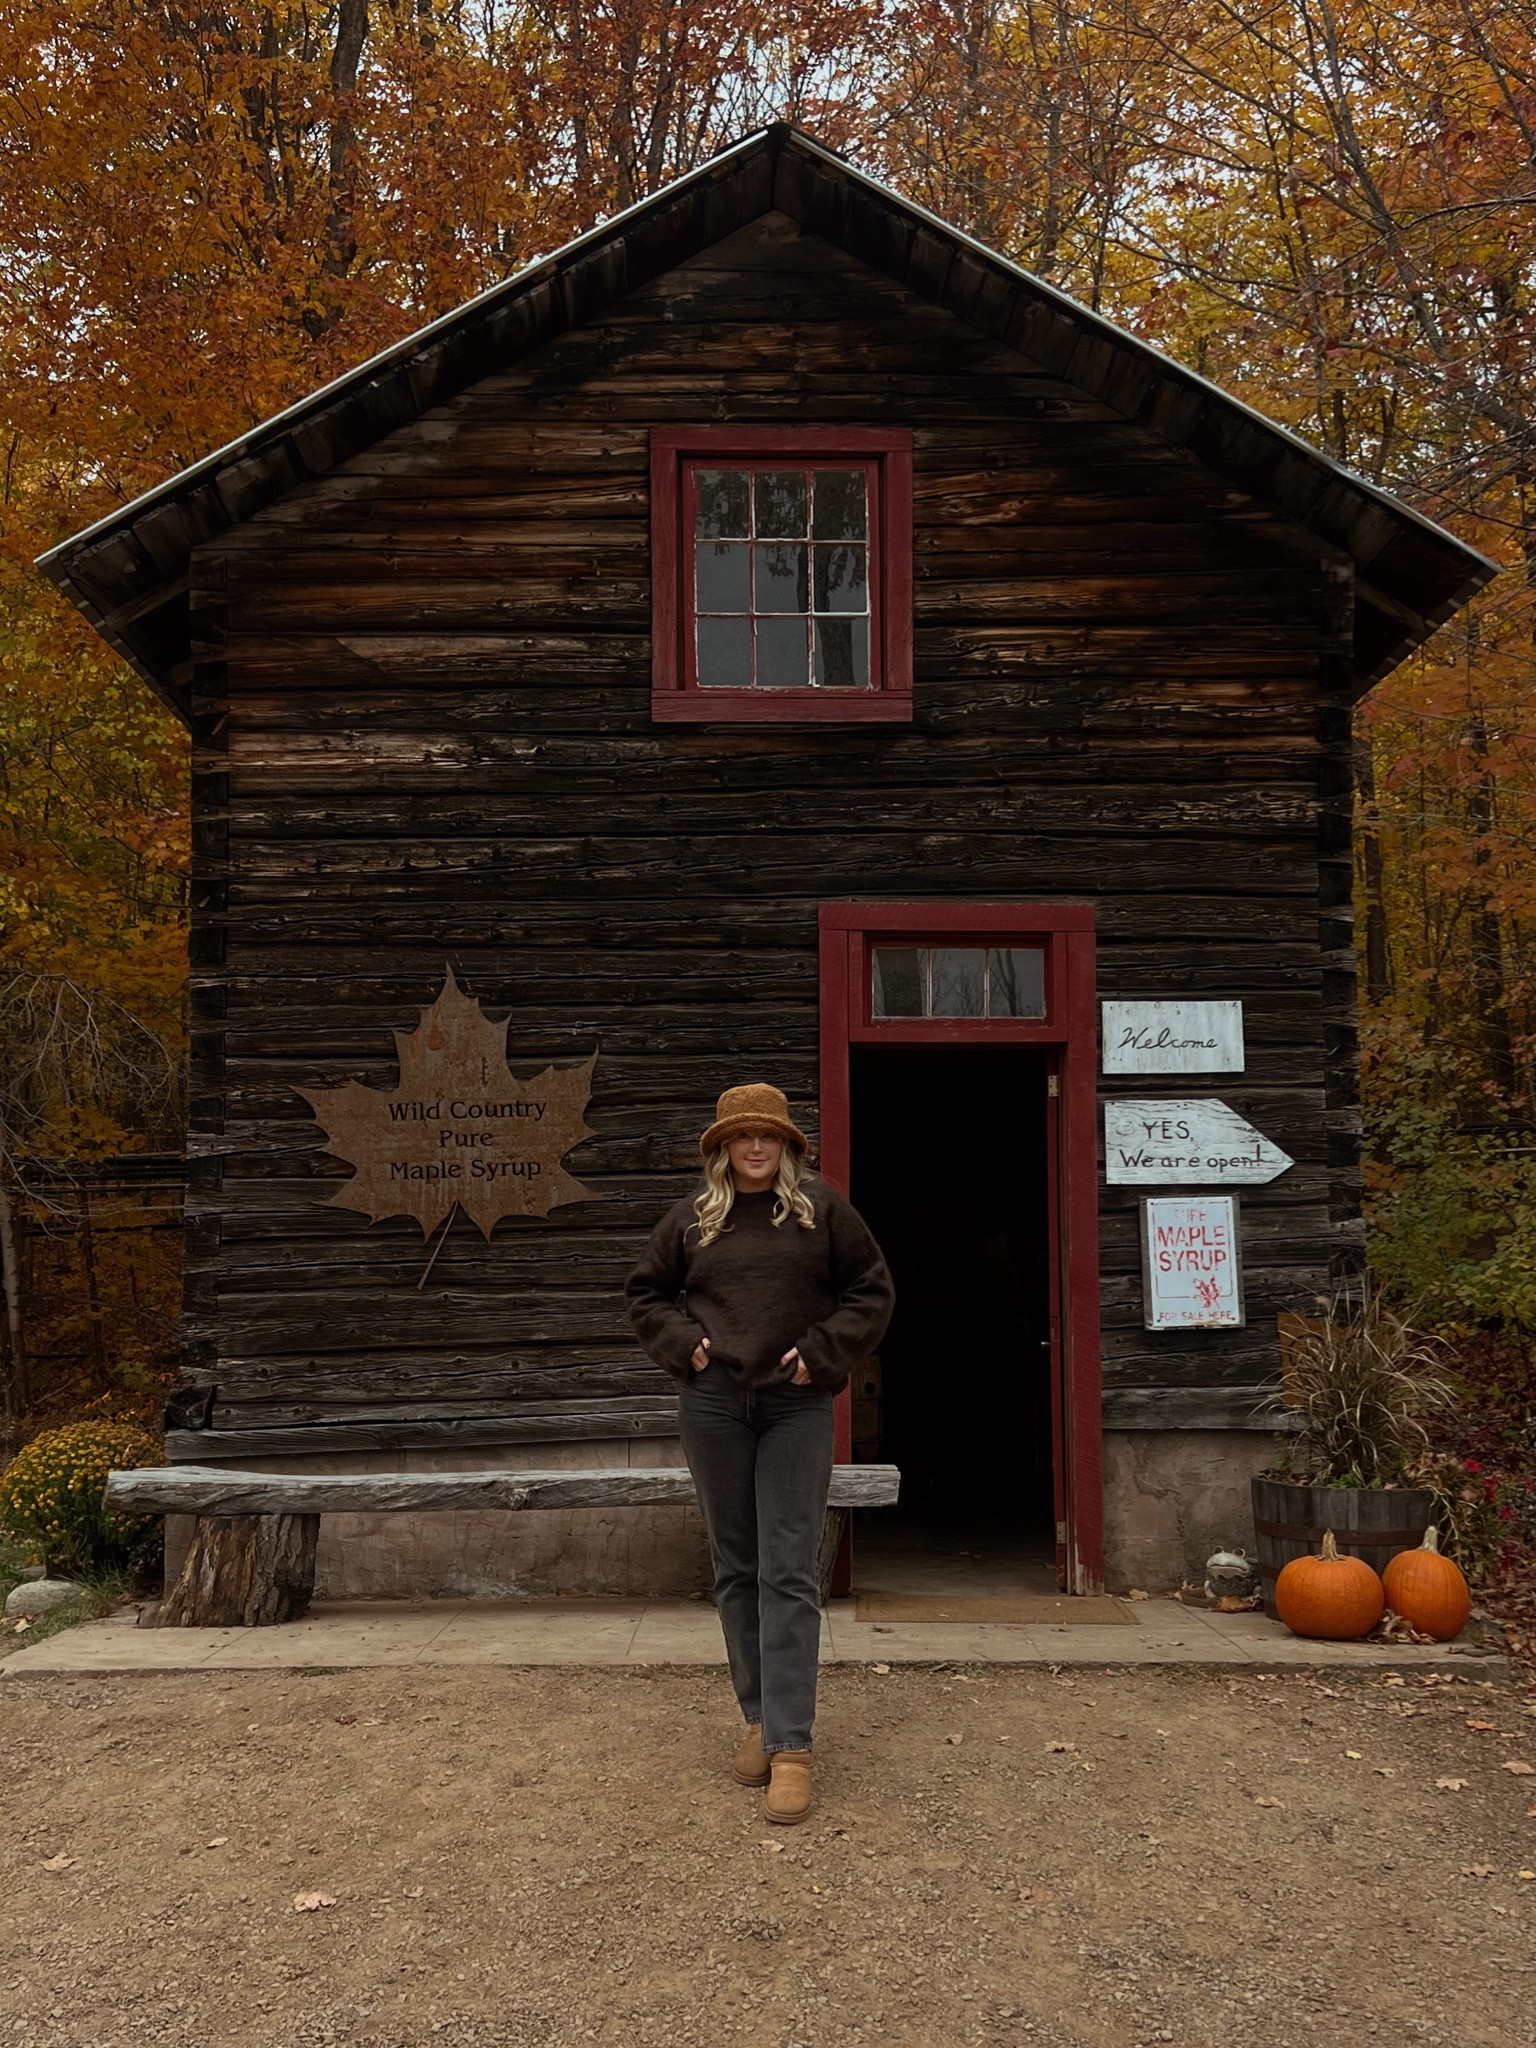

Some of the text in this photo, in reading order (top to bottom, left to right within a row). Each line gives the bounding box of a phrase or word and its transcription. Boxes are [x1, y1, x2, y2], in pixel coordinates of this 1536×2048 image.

[1117, 1027, 1218, 1050] Welcome
[388, 1100, 547, 1121] Wild Country
[438, 1130, 493, 1148] Pure
[1119, 1144, 1261, 1173] We are open!
[390, 1159, 541, 1182] Maple Syrup
[1157, 1226, 1226, 1247] MAPLE
[1159, 1250, 1227, 1272] SYRUP
